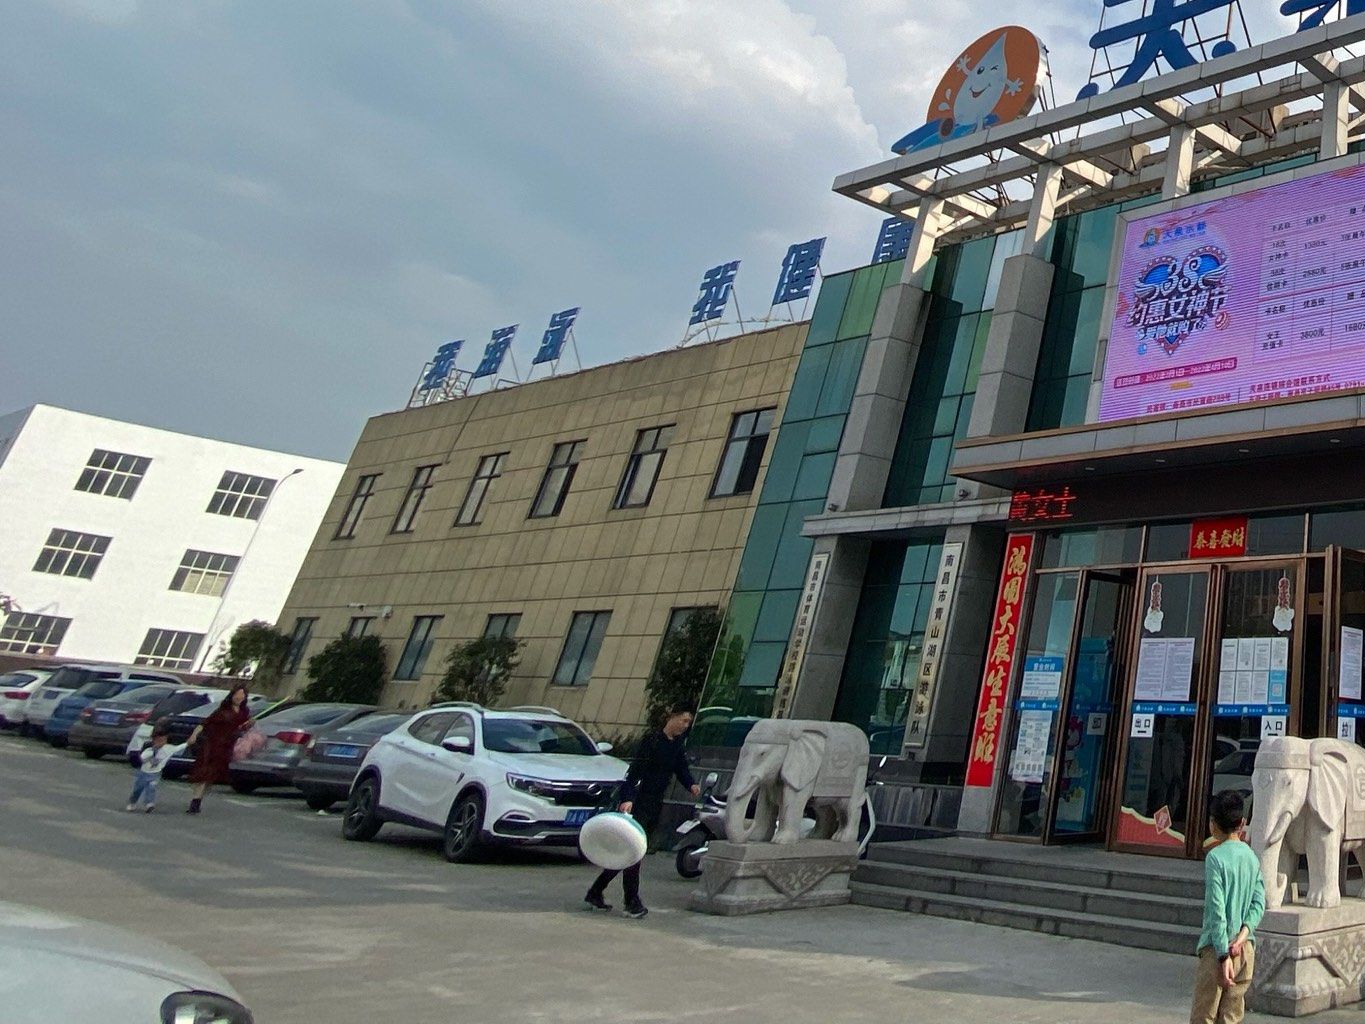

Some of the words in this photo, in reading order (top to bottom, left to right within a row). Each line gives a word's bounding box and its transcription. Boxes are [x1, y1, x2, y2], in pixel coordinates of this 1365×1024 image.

[910, 554, 955, 735] 南昌市青山湖区游泳队
[1264, 720, 1283, 731] 入口
